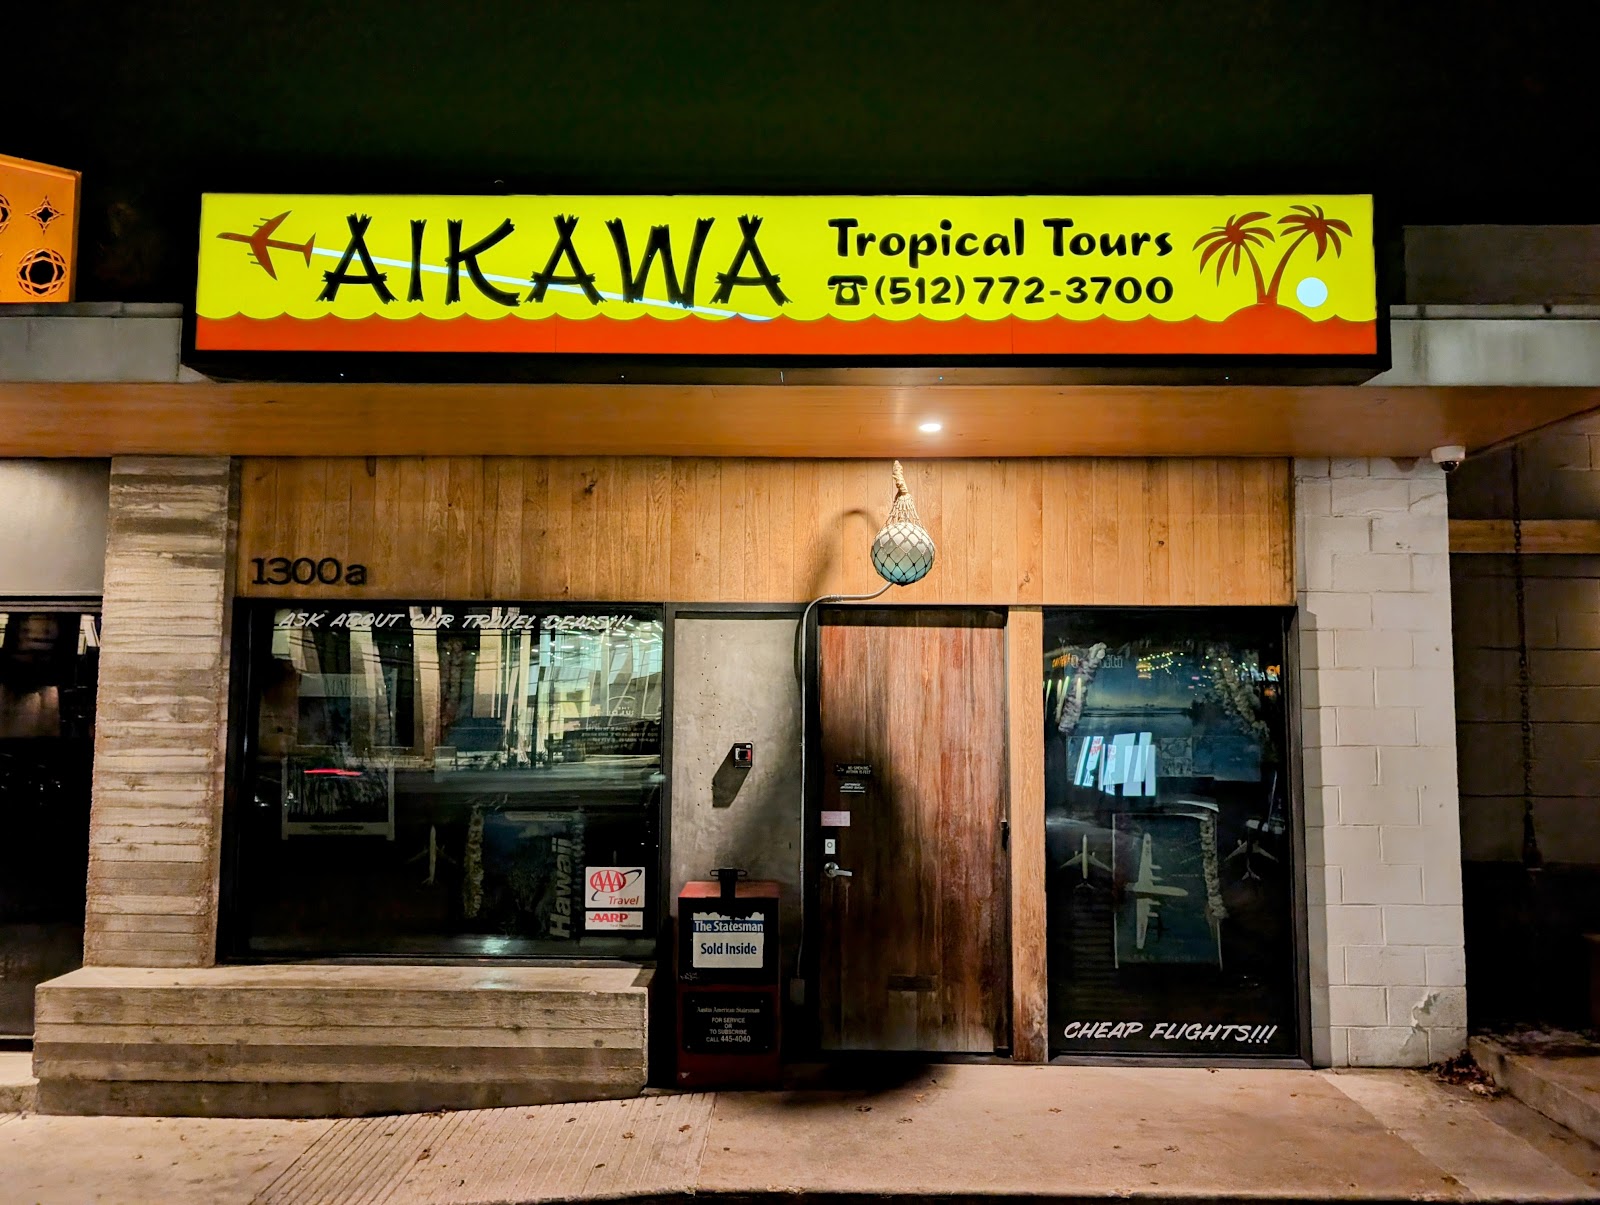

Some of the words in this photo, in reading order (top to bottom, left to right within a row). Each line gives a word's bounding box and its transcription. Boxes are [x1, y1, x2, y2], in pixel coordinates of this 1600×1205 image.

[828, 218, 1025, 268] Tropical
[1043, 218, 1173, 257] Tours
[315, 213, 793, 308] AIKAWA
[278, 612, 326, 628] ASK
[330, 613, 405, 628] ABOUT
[410, 613, 454, 629] OUR
[462, 614, 536, 629] TRAVEL
[549, 836, 573, 939] Hawaii
[592, 870, 624, 893] AAA
[608, 895, 640, 905] Travel
[592, 913, 629, 923] AARP
[694, 920, 712, 932] The
[713, 920, 764, 932] Statesman
[700, 942, 723, 955] Sold
[725, 942, 757, 955] Inside
[720, 1035, 751, 1043] 445-4040
[1063, 1021, 1144, 1039] CHEAP
[1149, 1022, 1278, 1044] FLIGHTS!!!
